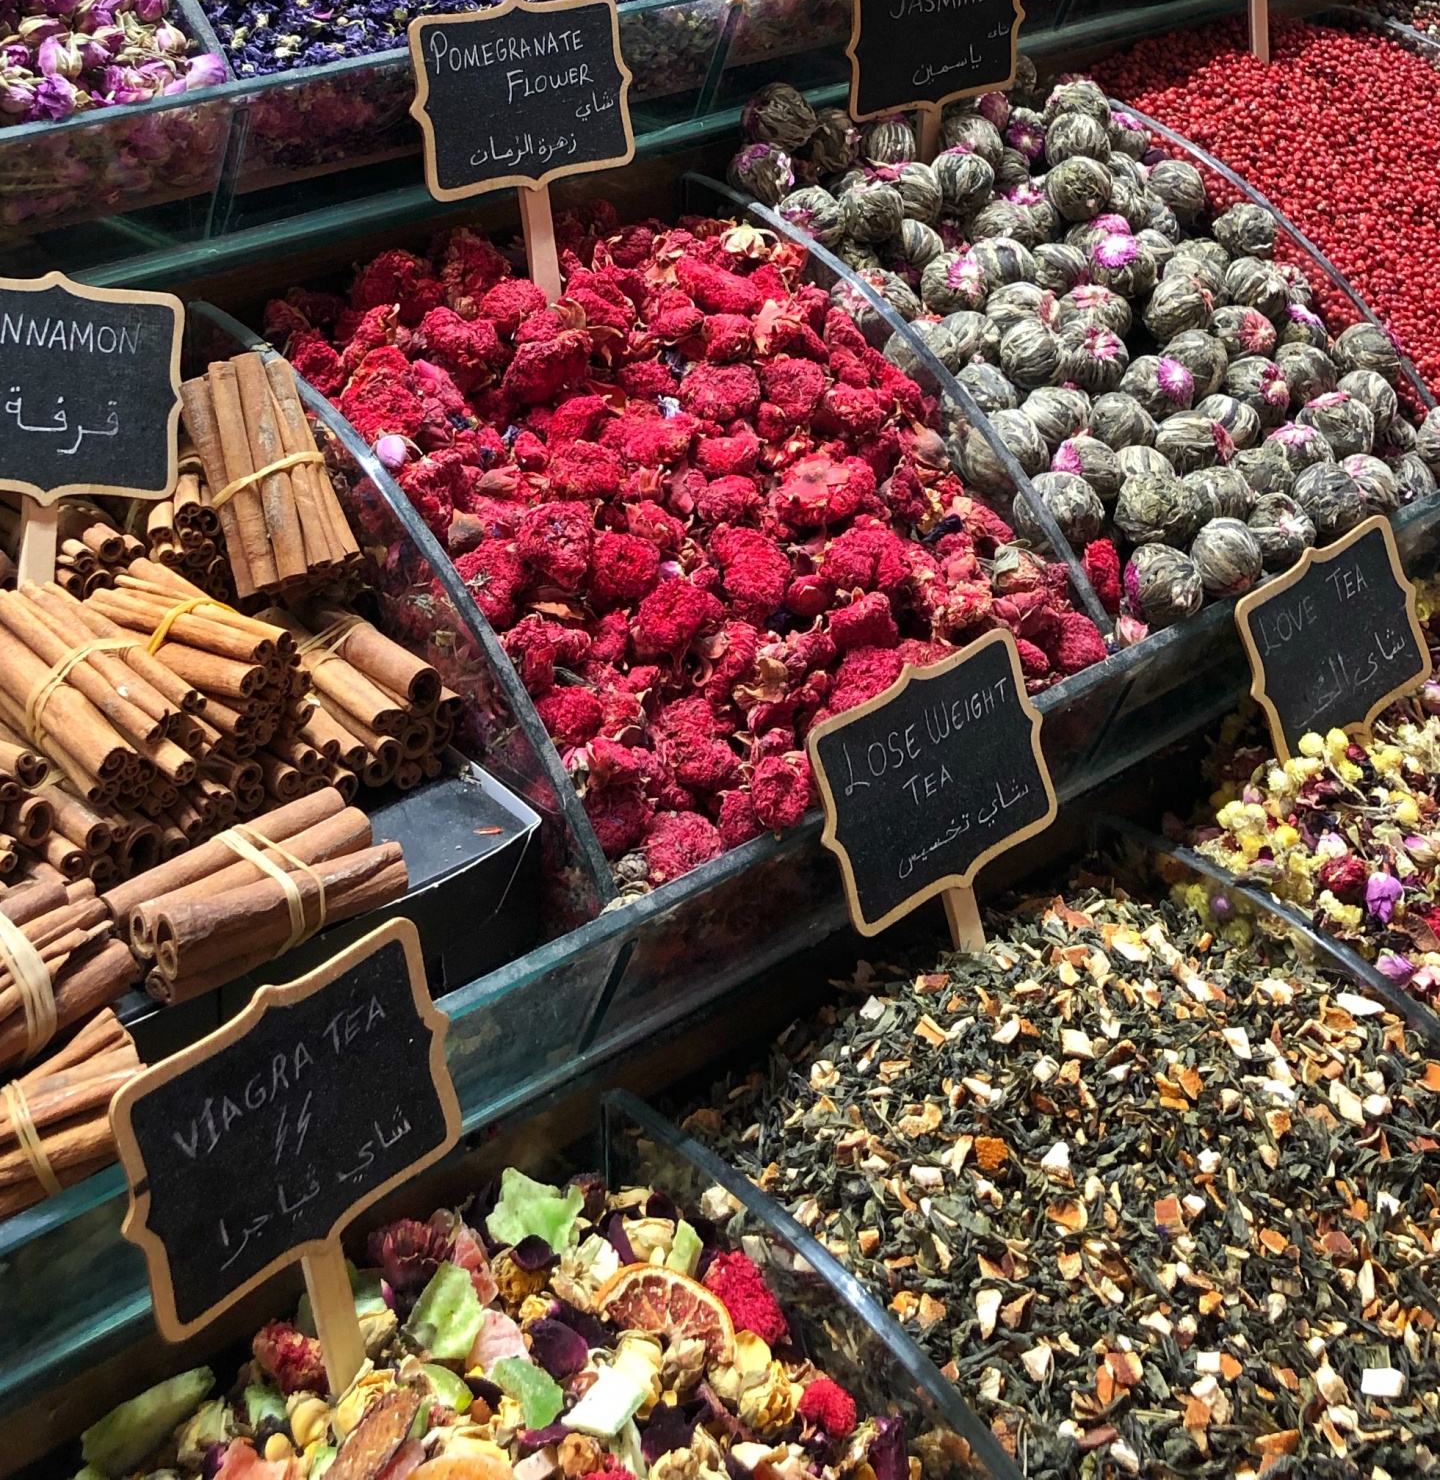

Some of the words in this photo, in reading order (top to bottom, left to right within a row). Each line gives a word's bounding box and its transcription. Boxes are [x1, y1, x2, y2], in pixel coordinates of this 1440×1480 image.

[430, 30, 584, 74] POMEGRANATE
[912, 44, 982, 86] ياسمين
[506, 64, 594, 104] FLOWER
[574, 90, 614, 122] شاي
[538, 132, 578, 164] زهرة
[5, 386, 120, 455] قرفة
[1258, 595, 1318, 657] LOVE
[1325, 563, 1368, 603] TEA
[842, 722, 922, 796] LOSE
[924, 676, 1008, 745] WEIGHT
[902, 764, 954, 806] TEA
[977, 778, 1030, 828] شاي
[172, 1041, 314, 1160] VIAGRA
[322, 994, 386, 1054] TEA
[338, 1104, 412, 1183] شاي
